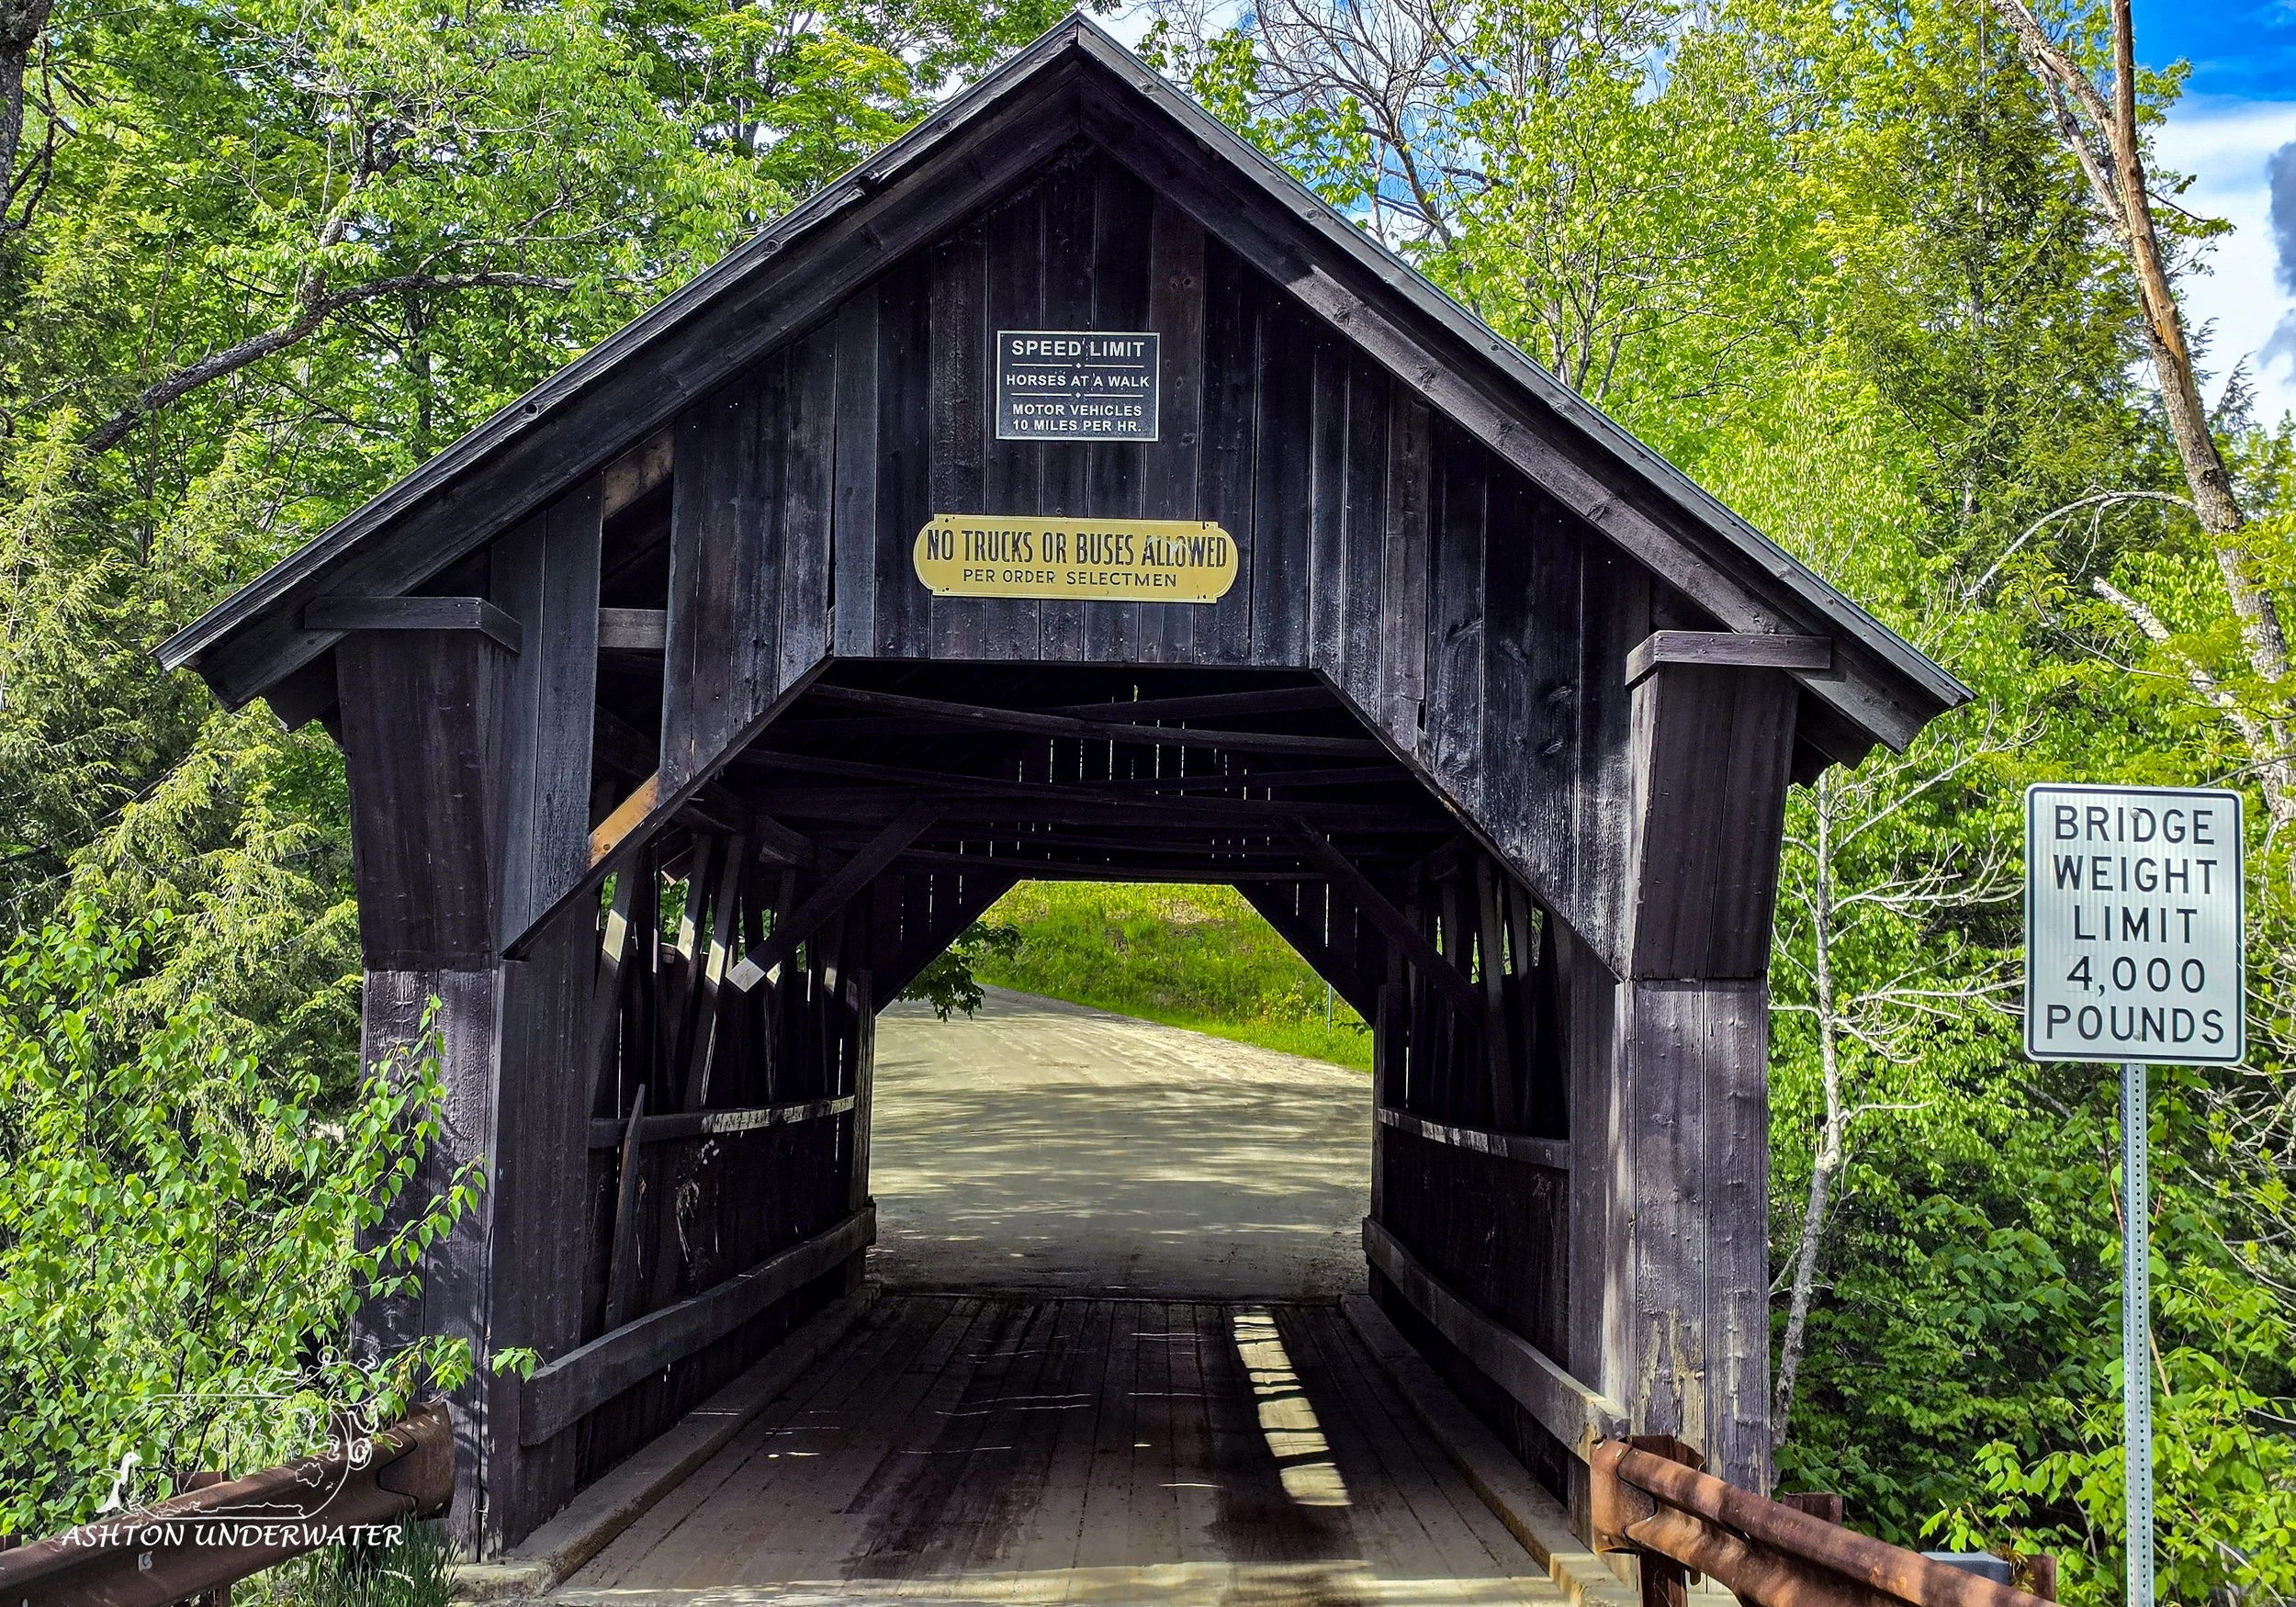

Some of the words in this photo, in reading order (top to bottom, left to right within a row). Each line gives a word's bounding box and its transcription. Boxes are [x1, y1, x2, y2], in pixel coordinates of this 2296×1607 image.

[1011, 340, 1081, 356] SPEED
[1090, 342, 1144, 356] LIMIT
[1007, 375, 1065, 386] HORSES
[1071, 376, 1089, 386] AT
[1093, 376, 1103, 386] A
[1109, 376, 1150, 387] WALK
[1013, 404, 1064, 415] MOTOR
[1070, 405, 1142, 416] VEHICLES
[1013, 420, 1028, 430] 10
[1034, 421, 1076, 431] MILES
[1084, 421, 1111, 431] PER
[1118, 421, 1142, 432] HR.
[928, 529, 953, 560] NO
[962, 530, 1032, 563] TRUCKS
[1042, 533, 1067, 564] OR
[1076, 534, 1133, 566] BUSES
[1142, 535, 1227, 568] ALLOWED
[964, 569, 995, 582] PER
[1003, 569, 1054, 583] ORDER
[1067, 572, 1176, 587] SELECTMEN
[2054, 804, 2214, 845] BRIDGE
[2054, 855, 2217, 894] WEIGHT
[2074, 905, 2197, 943] LIMIT
[2066, 955, 2204, 996] 4,000
[2046, 1005, 2224, 1043] POUNDS
